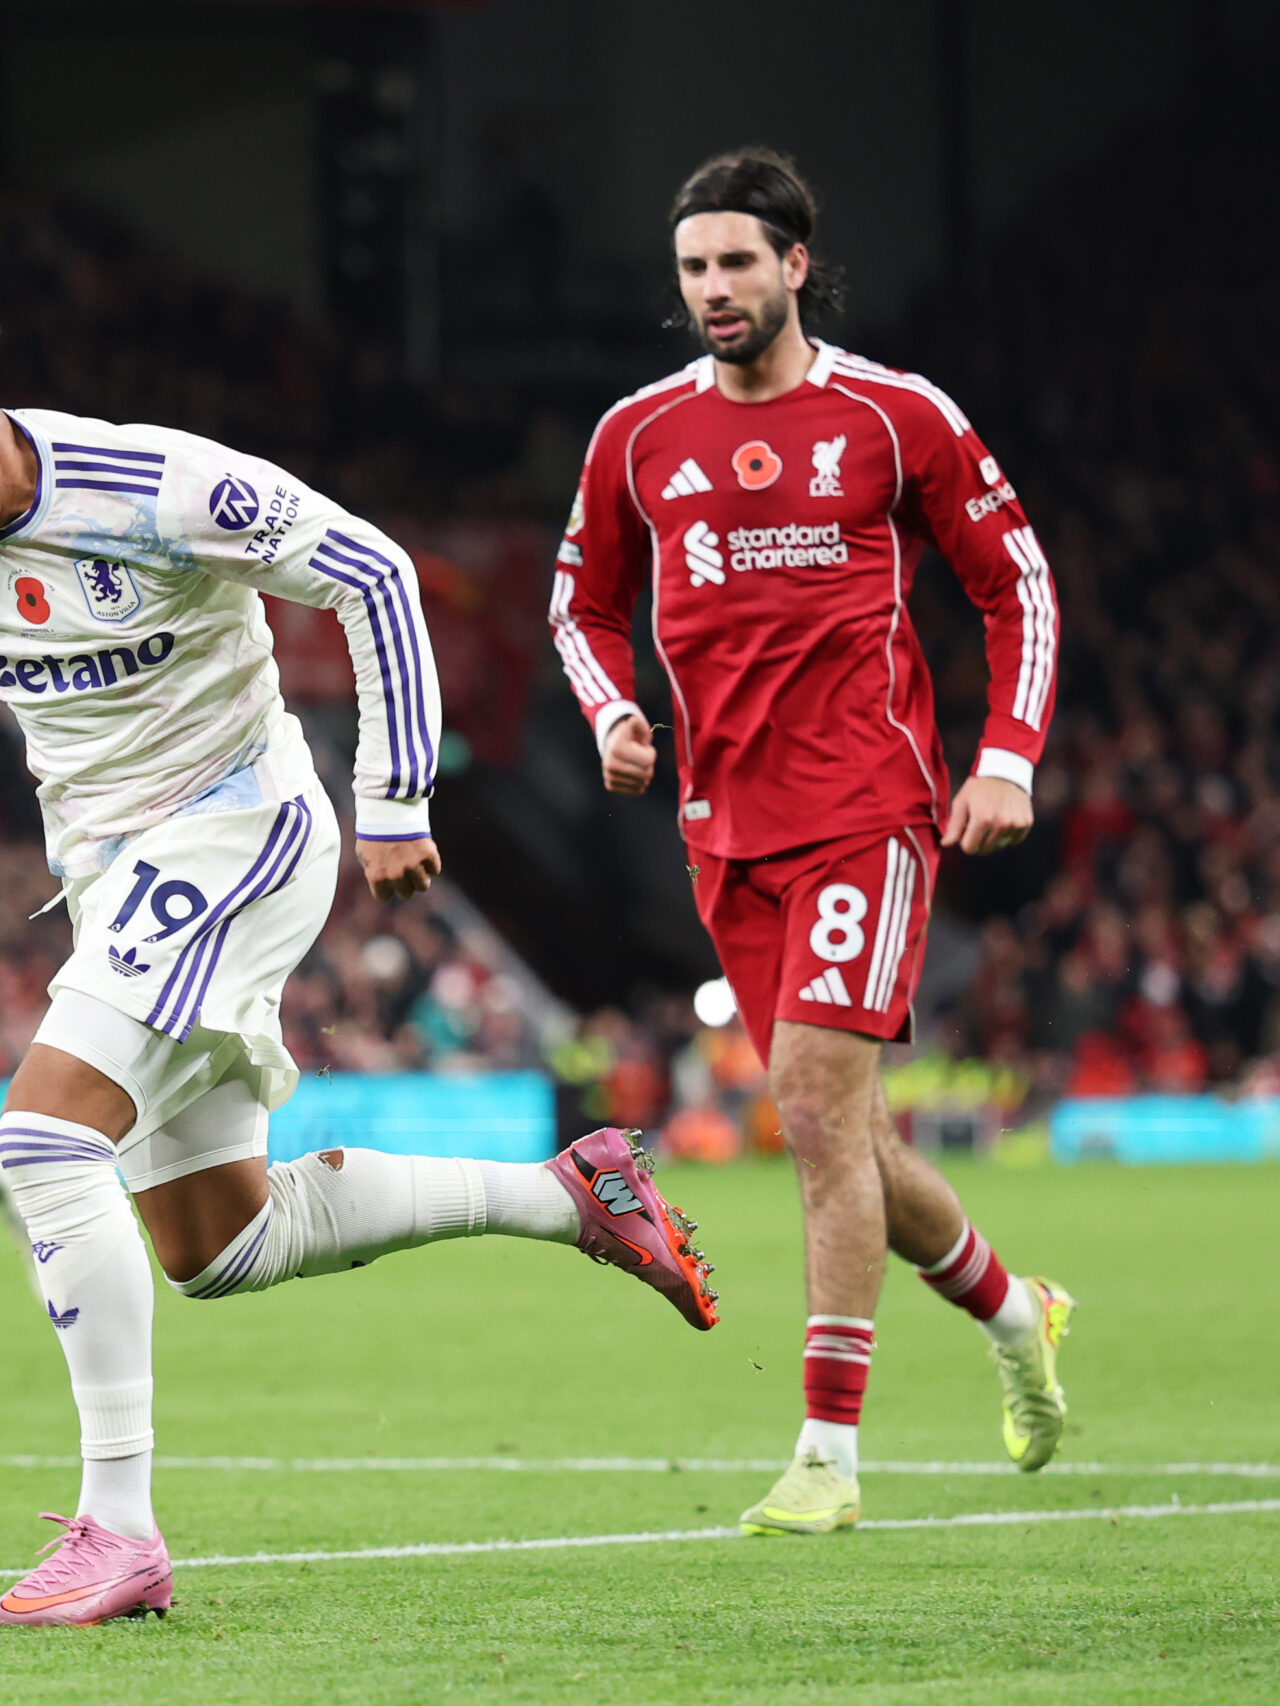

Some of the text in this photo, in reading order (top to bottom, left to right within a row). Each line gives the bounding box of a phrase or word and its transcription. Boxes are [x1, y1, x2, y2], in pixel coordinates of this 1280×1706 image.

[245, 485, 287, 554] TRADE
[261, 493, 300, 565] NATION
[726, 521, 841, 552] standard
[730, 542, 849, 572] chartered
[96, 610, 119, 618] ASTON
[119, 600, 136, 615] VILLA
[108, 859, 208, 944] 19
[809, 882, 868, 963] 8
